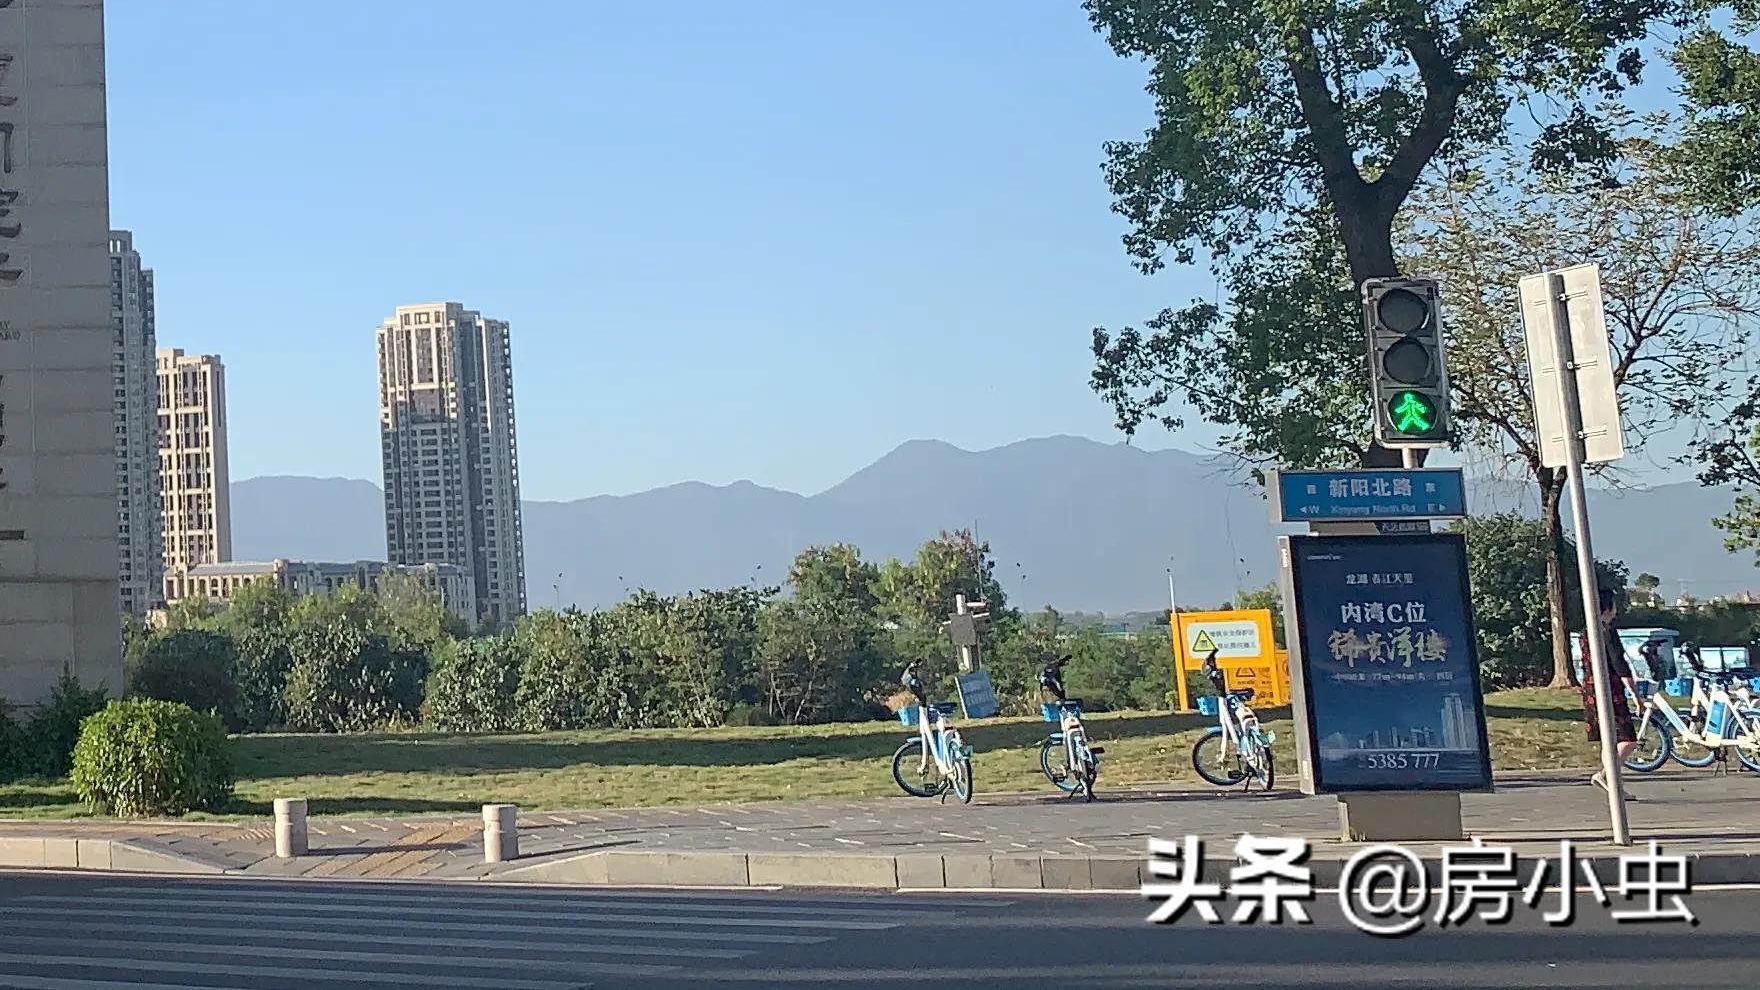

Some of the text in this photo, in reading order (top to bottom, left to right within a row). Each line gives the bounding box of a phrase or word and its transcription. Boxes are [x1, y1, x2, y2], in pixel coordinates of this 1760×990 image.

[1328, 478, 1413, 498] 新阳北路
[1341, 601, 1427, 624] 内湾C位
[1367, 753, 1440, 769] 5385 777
